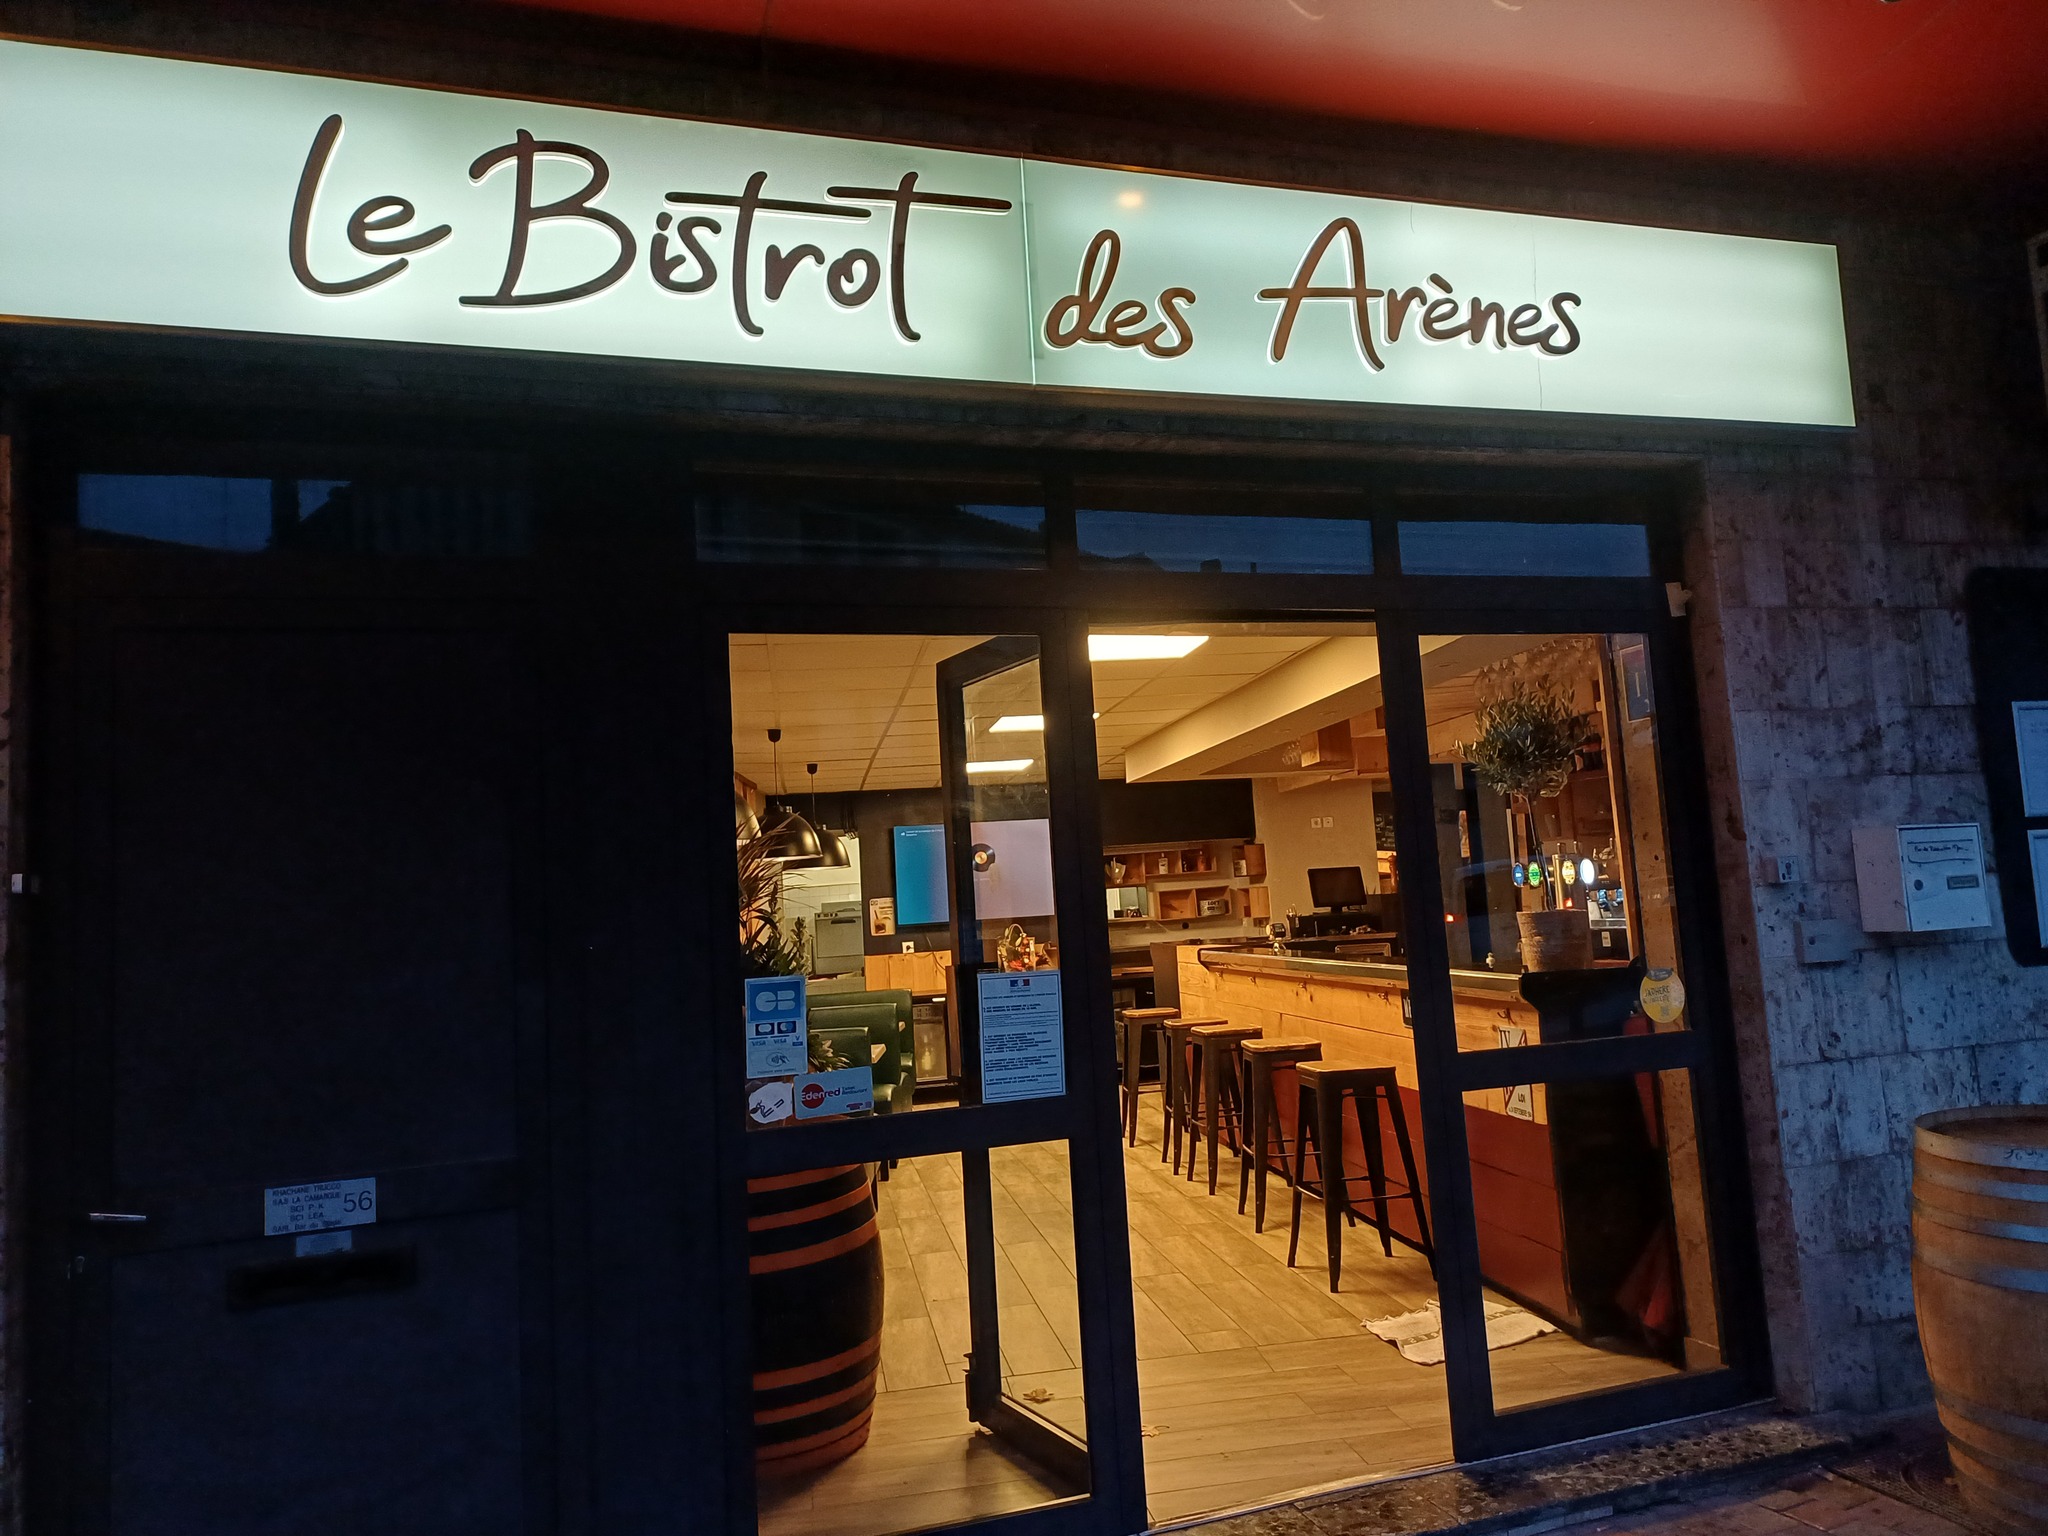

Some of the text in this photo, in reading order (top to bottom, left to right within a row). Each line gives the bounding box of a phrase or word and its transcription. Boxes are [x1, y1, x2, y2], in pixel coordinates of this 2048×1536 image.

[289, 113, 1582, 373] Le Bistrot des Arènes
[801, 1088, 841, 1102] Edenred
[343, 1190, 373, 1213] 56
